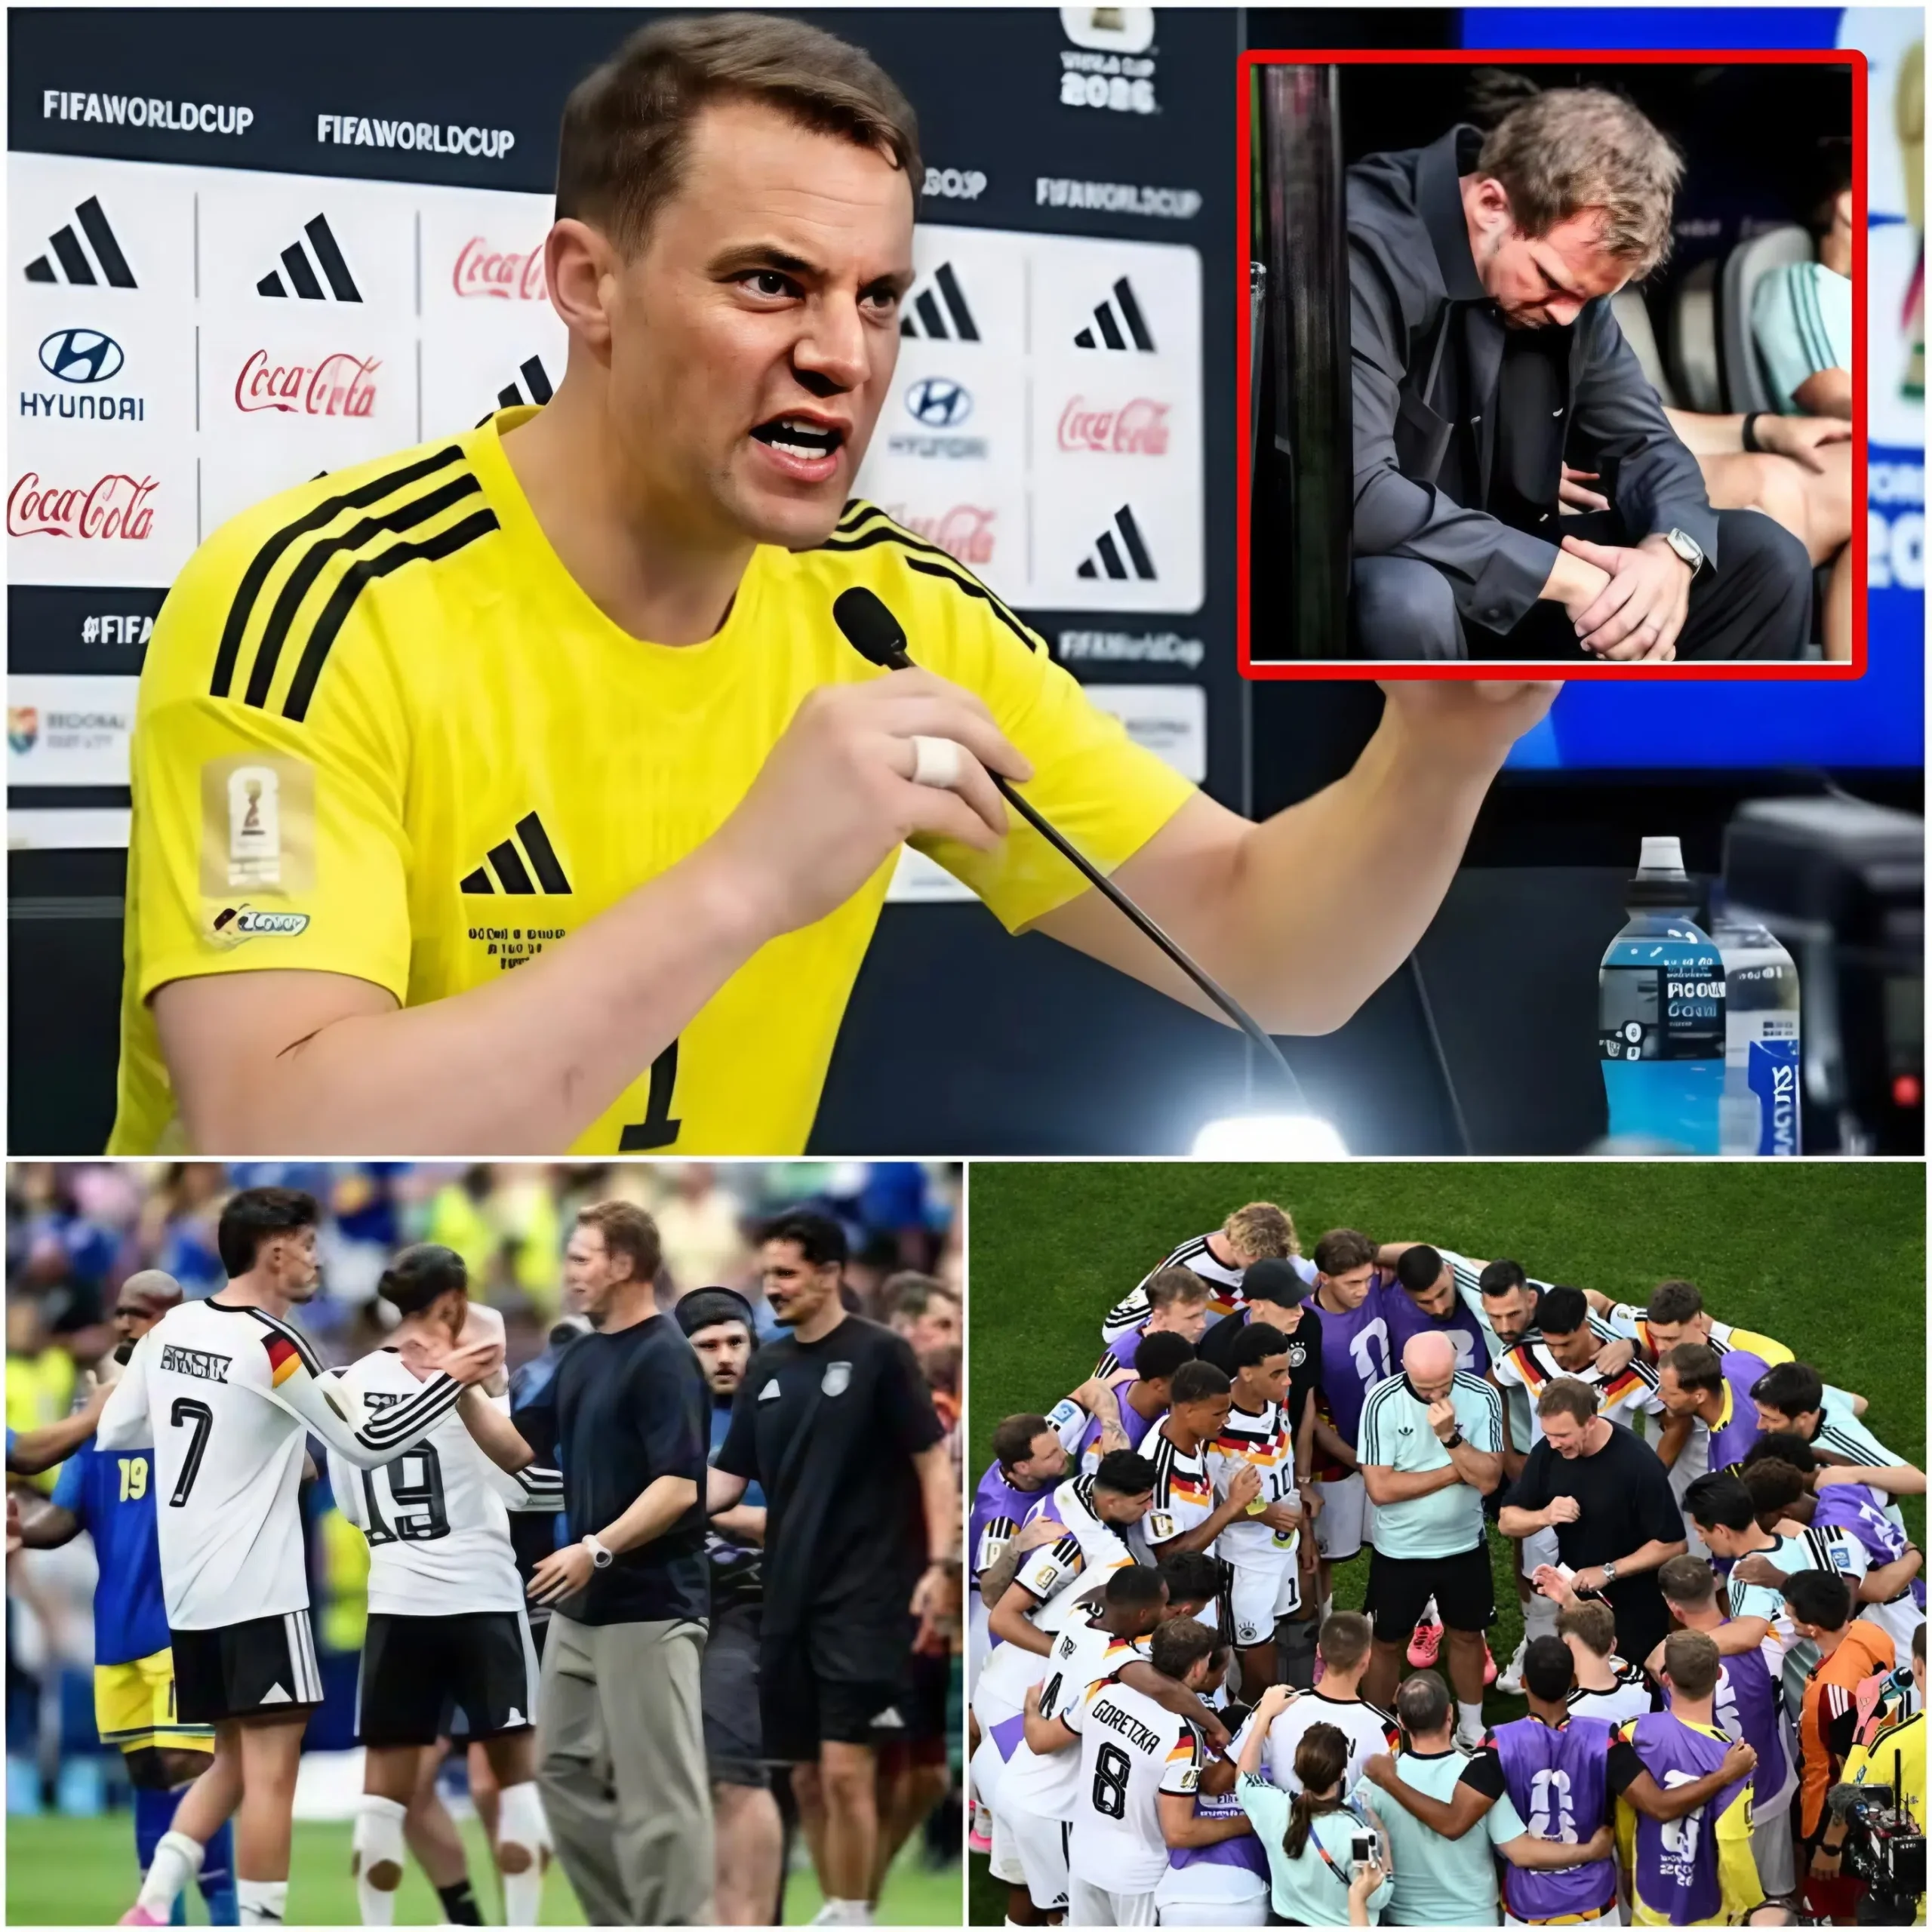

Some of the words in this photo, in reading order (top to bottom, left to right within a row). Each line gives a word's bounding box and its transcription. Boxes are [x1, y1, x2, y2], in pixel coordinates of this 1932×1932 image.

[44, 90, 254, 135] FIFAWORLDCUP
[317, 114, 515, 159] FIFAWORLDCUP
[20, 392, 144, 421] HYUNDAI
[168, 1397, 214, 1508] 7
[118, 1457, 149, 1503] 19
[1091, 1699, 1161, 1755] GORETZKA
[1092, 1741, 1132, 1820] 8
